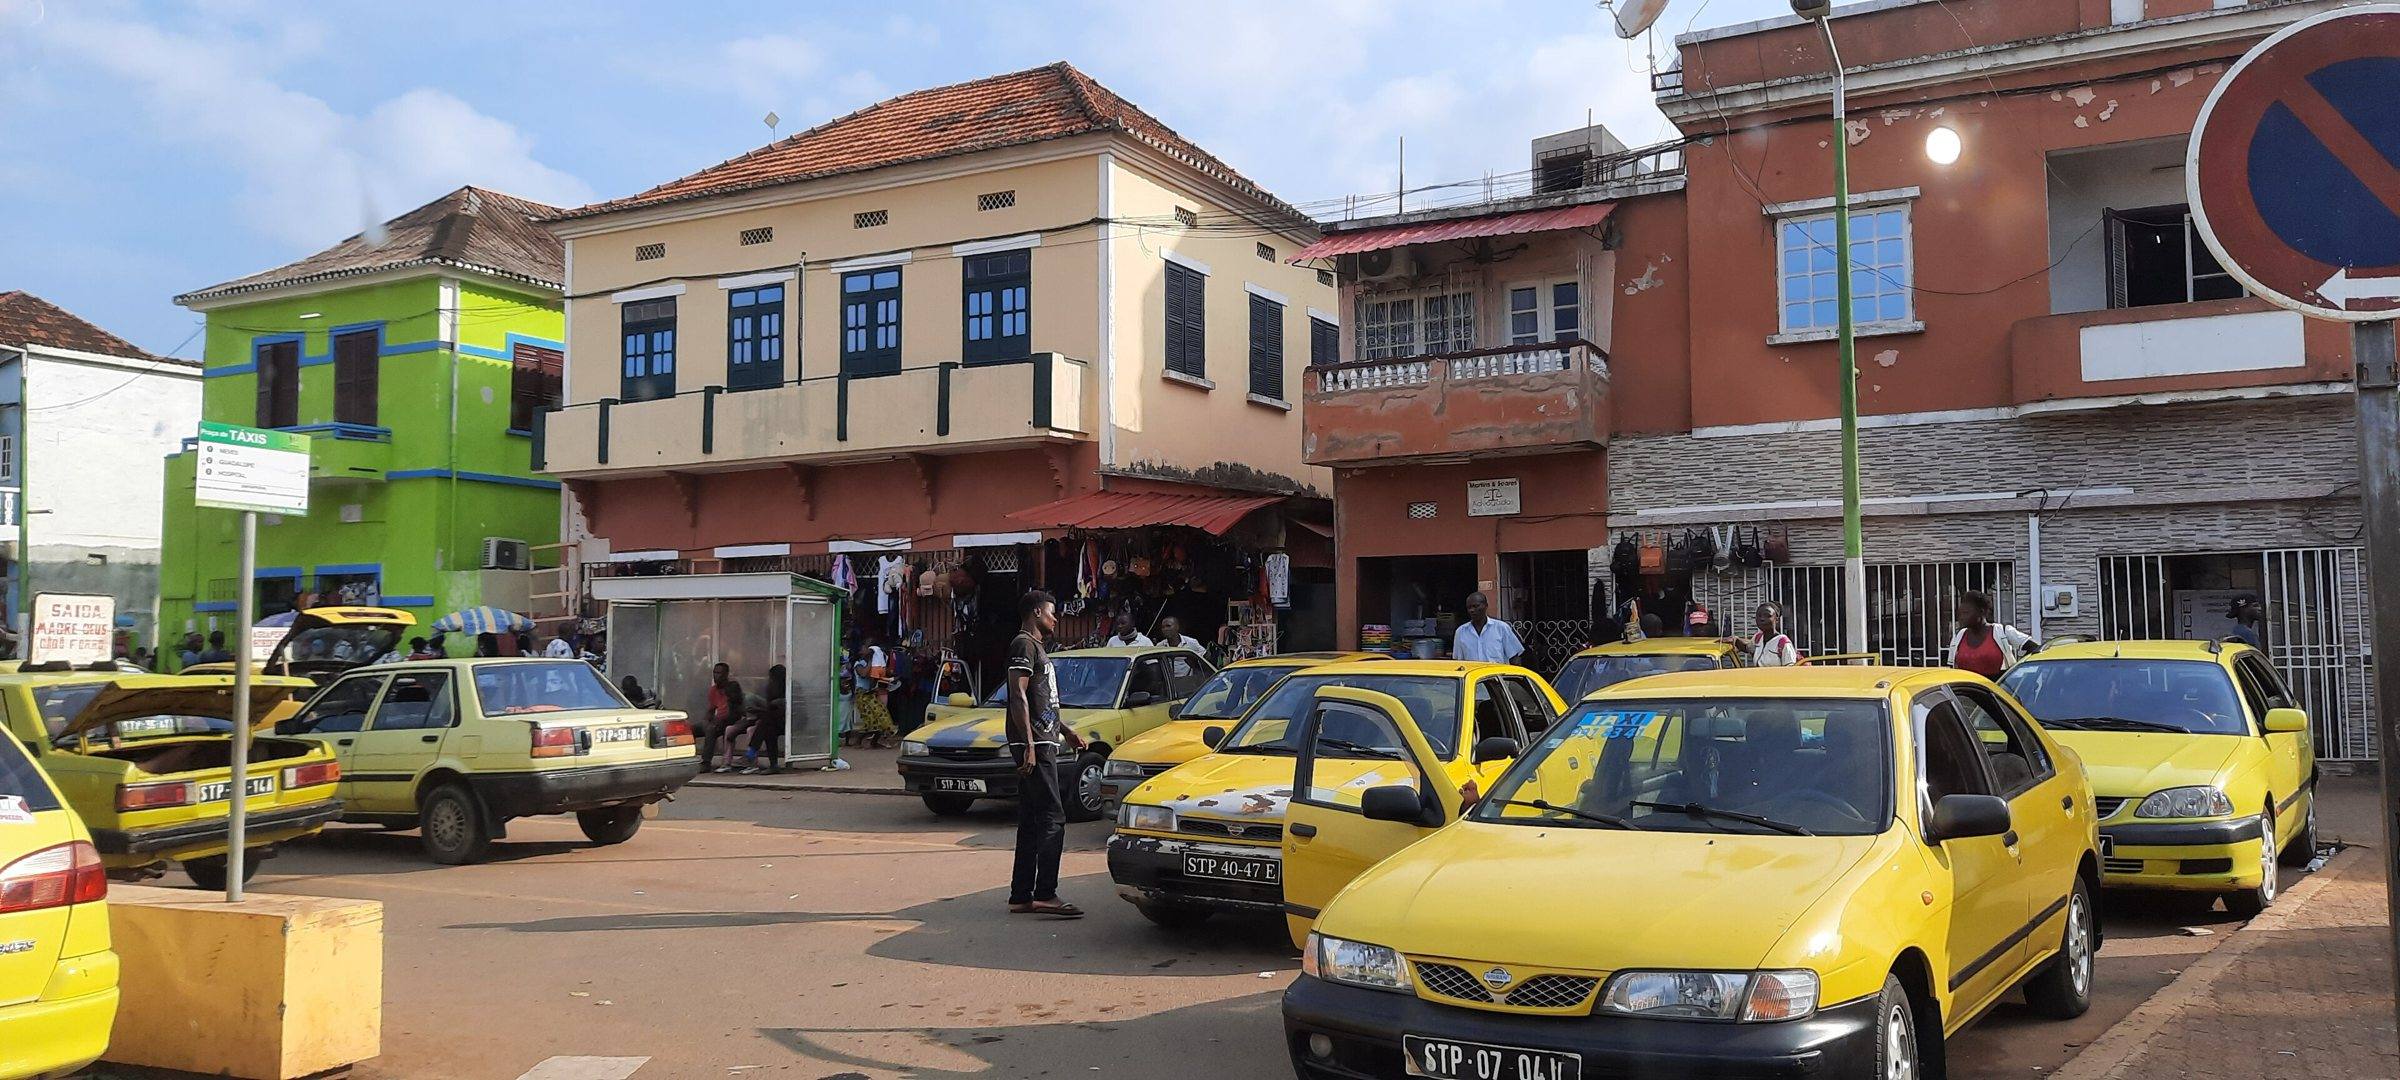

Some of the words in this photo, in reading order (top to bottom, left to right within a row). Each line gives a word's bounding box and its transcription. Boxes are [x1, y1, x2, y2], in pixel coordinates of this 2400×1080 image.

[229, 428, 268, 445] TÁXIS
[1591, 712, 1647, 726] TAXI
[1187, 857, 1217, 874] STP
[1221, 860, 1261, 878] 40-47
[1265, 863, 1276, 880] E
